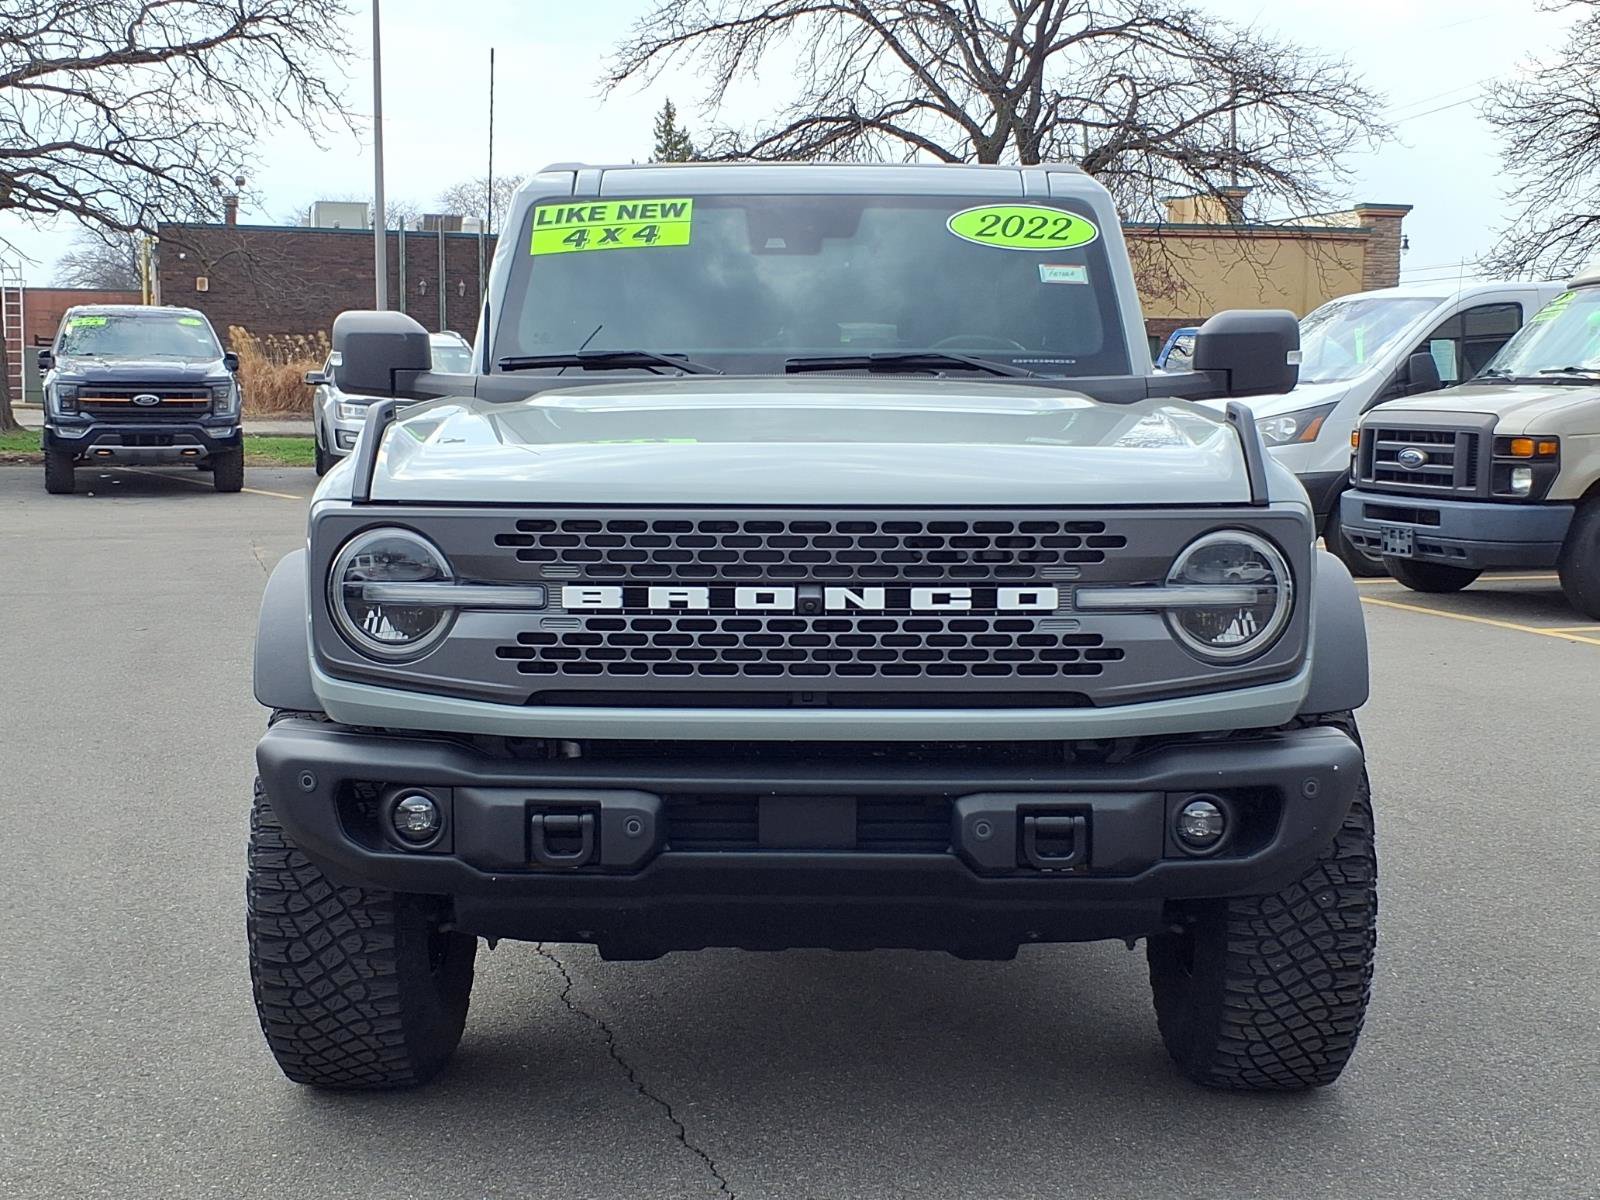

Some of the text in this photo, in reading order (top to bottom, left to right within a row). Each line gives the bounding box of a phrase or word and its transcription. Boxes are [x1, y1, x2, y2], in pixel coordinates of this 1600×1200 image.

[536, 203, 688, 226] LIKE NEW
[974, 214, 1073, 240] 2022
[561, 585, 1059, 611] BRONCO
